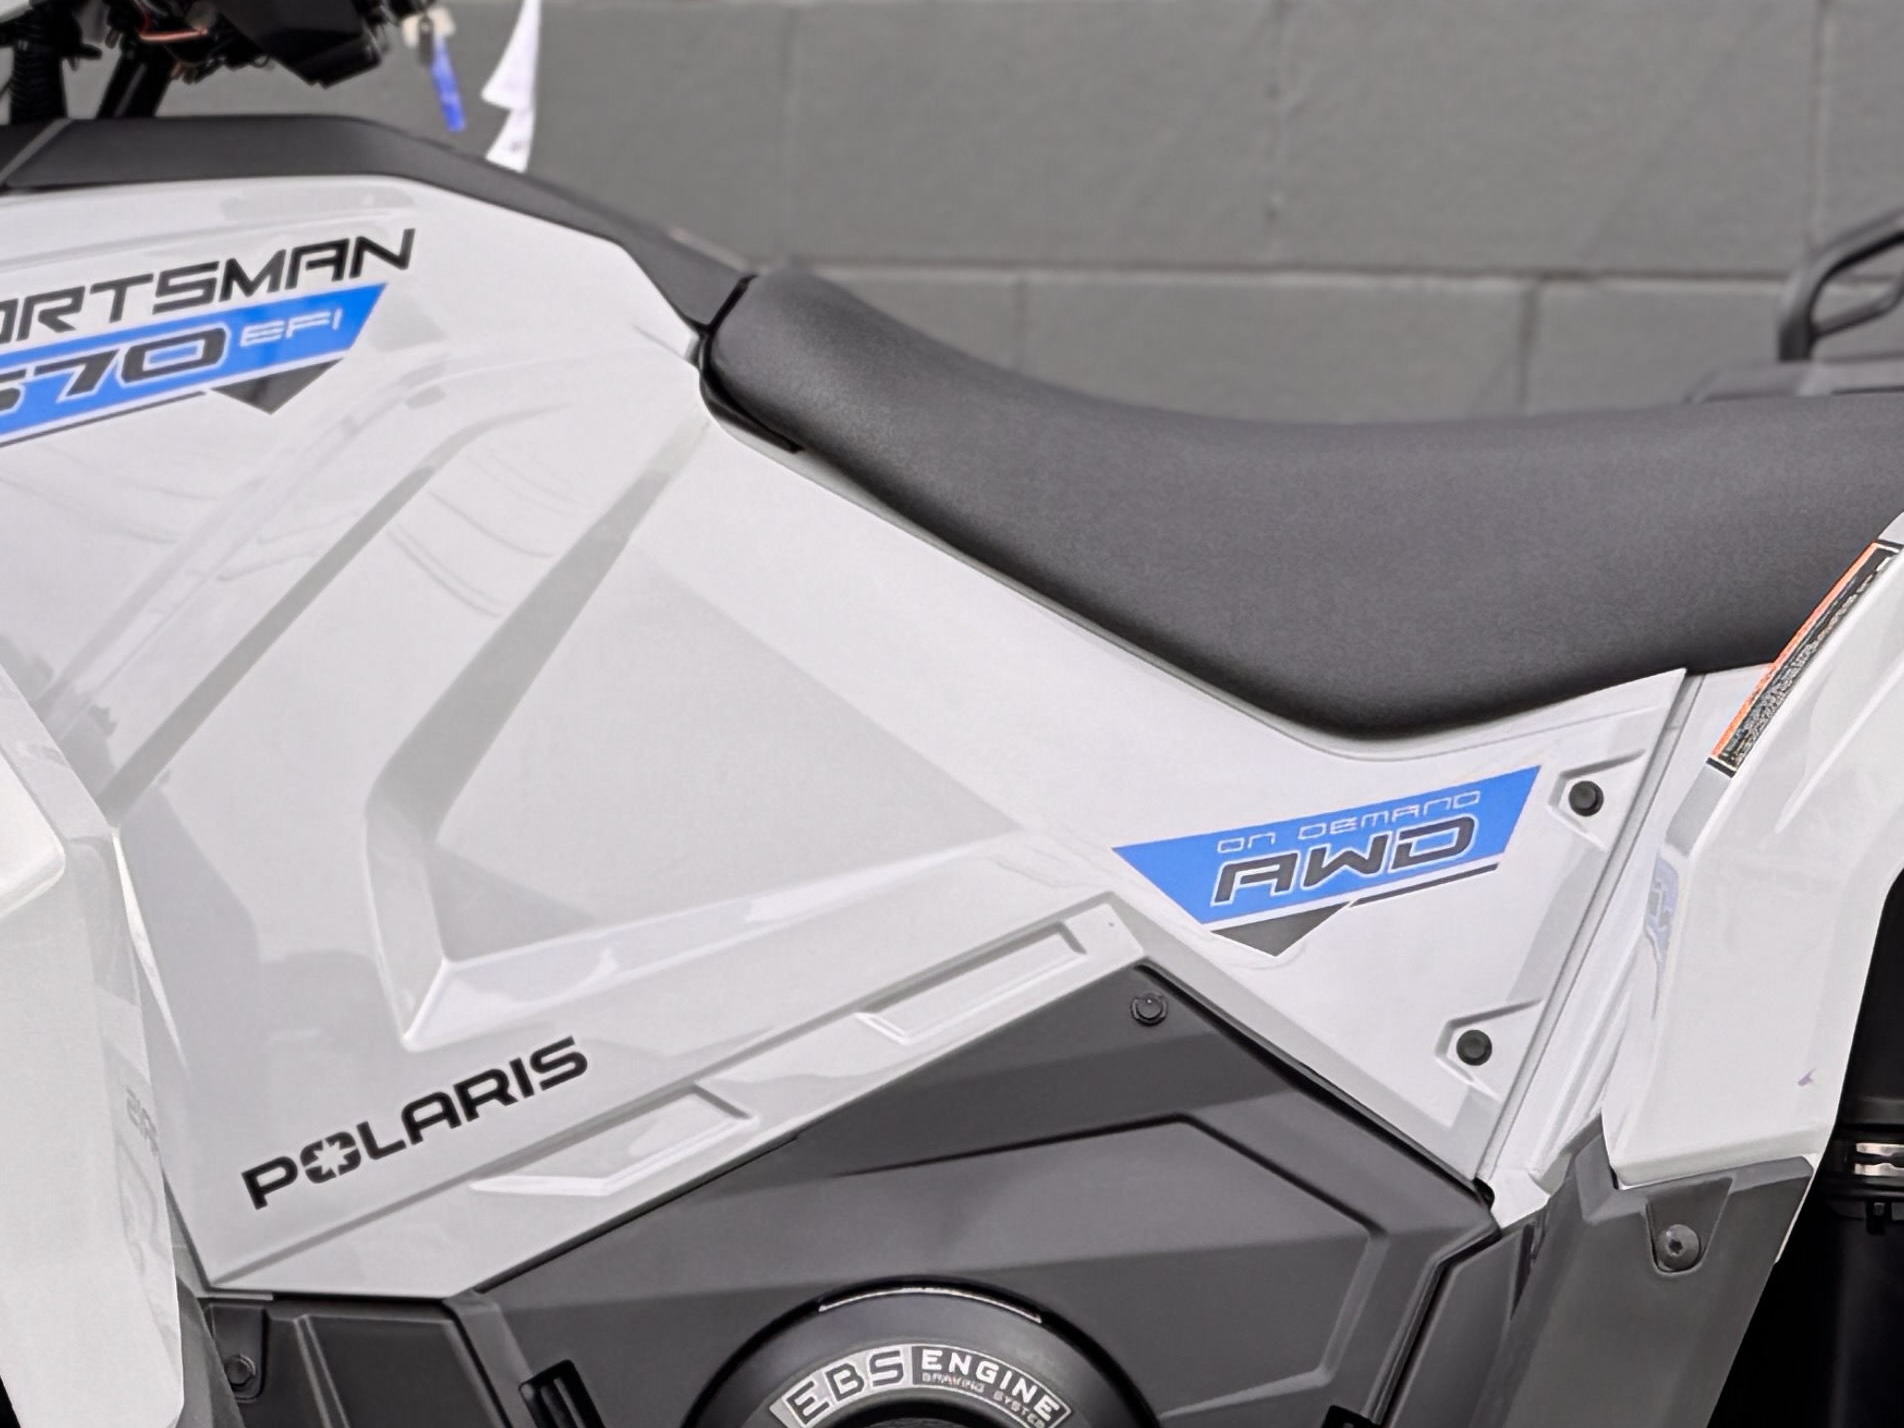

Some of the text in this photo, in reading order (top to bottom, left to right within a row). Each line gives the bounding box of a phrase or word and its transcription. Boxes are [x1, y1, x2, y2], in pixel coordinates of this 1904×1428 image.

[239, 309, 342, 348] EFI
[1298, 790, 1481, 841] DEMAND
[1210, 813, 1479, 908] AWD
[241, 1035, 588, 1210] POLARIS
[784, 1348, 1059, 1426] EBS ENGINE
